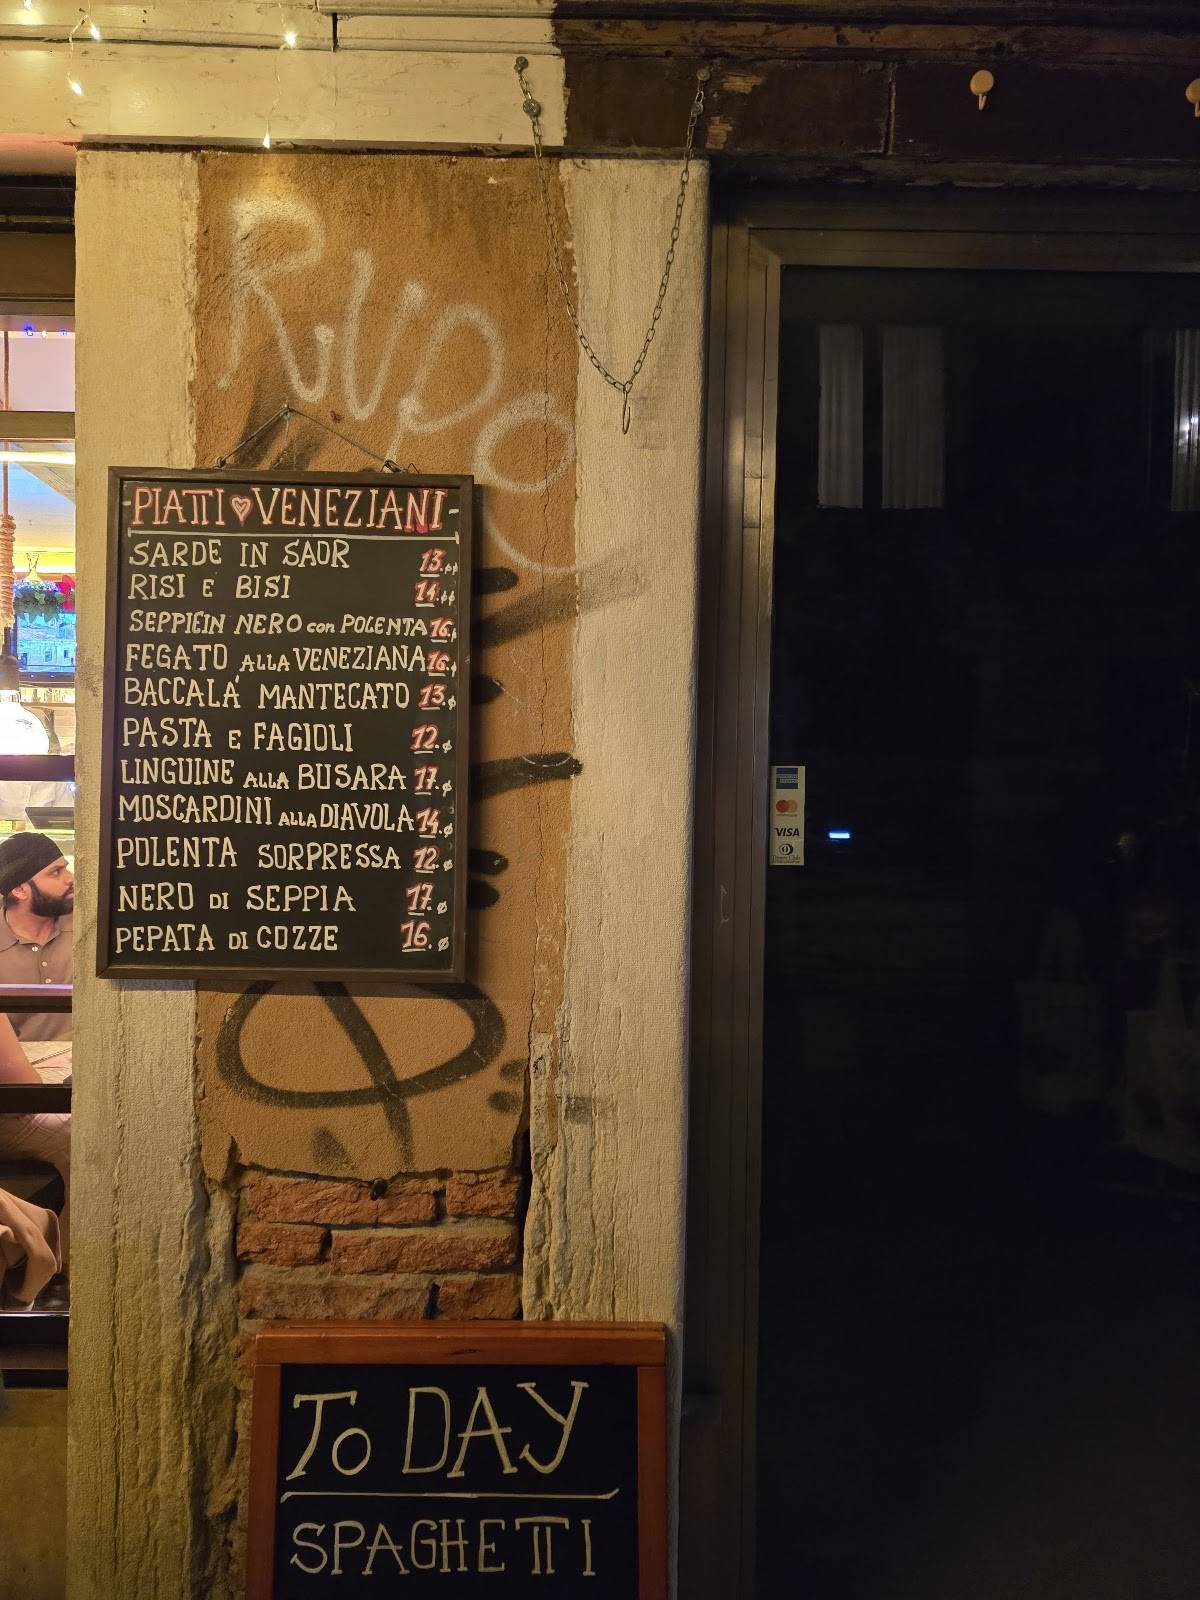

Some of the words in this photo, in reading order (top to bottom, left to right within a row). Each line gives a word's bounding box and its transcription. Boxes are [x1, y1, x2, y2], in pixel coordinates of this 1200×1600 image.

[131, 486, 226, 526] PIATTI
[252, 487, 448, 530] VENEZIANI
[129, 539, 222, 567] SARDE
[240, 541, 269, 567] IN
[282, 539, 350, 569] SAOR
[128, 574, 186, 600] RISI
[203, 578, 215, 597] E
[236, 575, 291, 599] BISI
[234, 612, 302, 634] NERO
[306, 622, 335, 633] con
[340, 614, 428, 636] POLENTA
[125, 643, 228, 671] FEGATO
[239, 653, 290, 672] ALLA
[293, 645, 426, 672] VENEZIANA
[258, 682, 410, 709] MANTECATO
[123, 717, 212, 748] PASTA
[228, 729, 241, 749] E
[254, 722, 354, 752] FAGIOLI
[120, 758, 234, 785] LINGUINE
[243, 771, 289, 789] ALLA
[298, 763, 406, 791] BUSARA
[118, 794, 272, 825] MOSCARDINI
[278, 812, 317, 828] ALLA
[320, 803, 414, 831] DIAVOLA
[775, 827, 800, 837] VISA
[116, 836, 237, 869] POLENTA
[258, 842, 401, 871] SORPRESSA
[117, 882, 193, 912] NERO
[209, 892, 229, 910] DI
[246, 884, 356, 912] SEPPIA
[115, 923, 215, 953] PEPATA
[228, 931, 248, 950] DI
[257, 926, 338, 951] COZZE
[402, 1381, 590, 1478] DAY
[290, 1516, 596, 1577] SPAGHETTI
